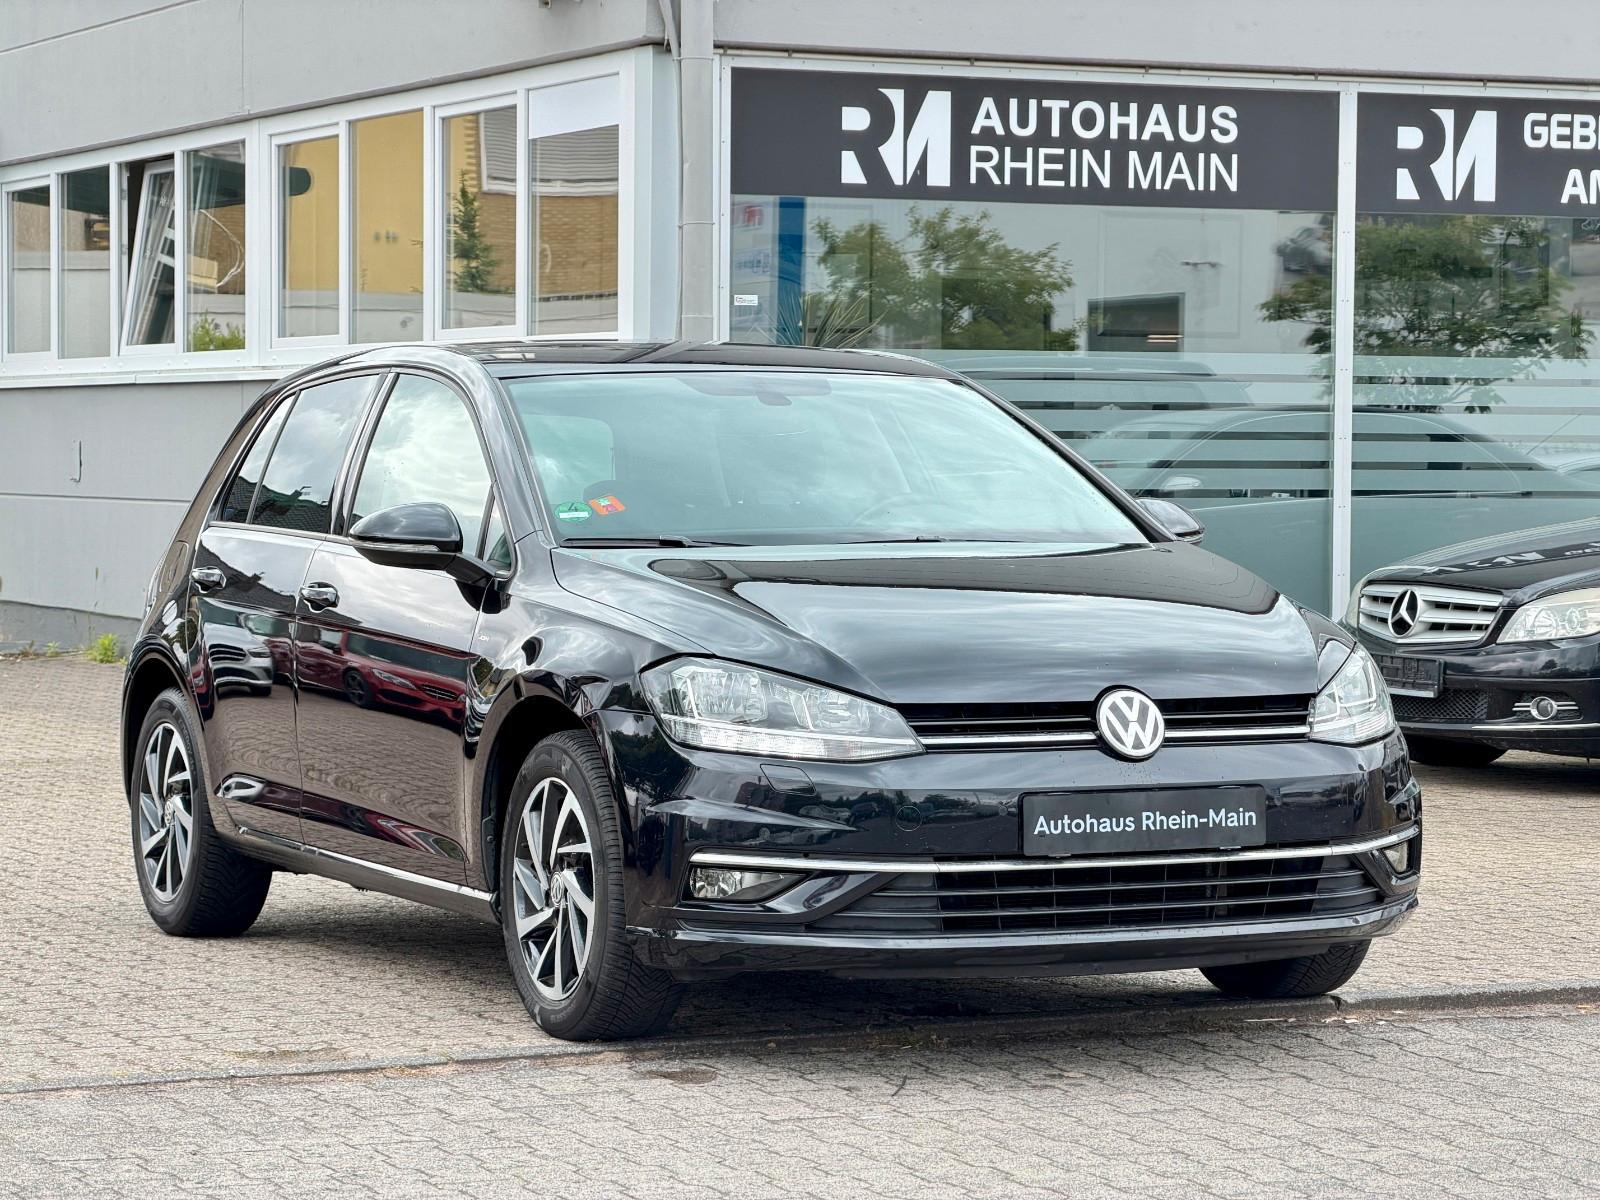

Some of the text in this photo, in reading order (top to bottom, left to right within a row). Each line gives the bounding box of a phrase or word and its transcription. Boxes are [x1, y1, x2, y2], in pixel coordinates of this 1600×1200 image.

[970, 96, 1239, 144] AUTOHAUS
[1523, 112, 1600, 151] GEB
[969, 145, 1238, 192] RHEIN MAIN
[1101, 691, 1163, 756] VW
[1033, 807, 1257, 836] Autohaus Rhein-Main
